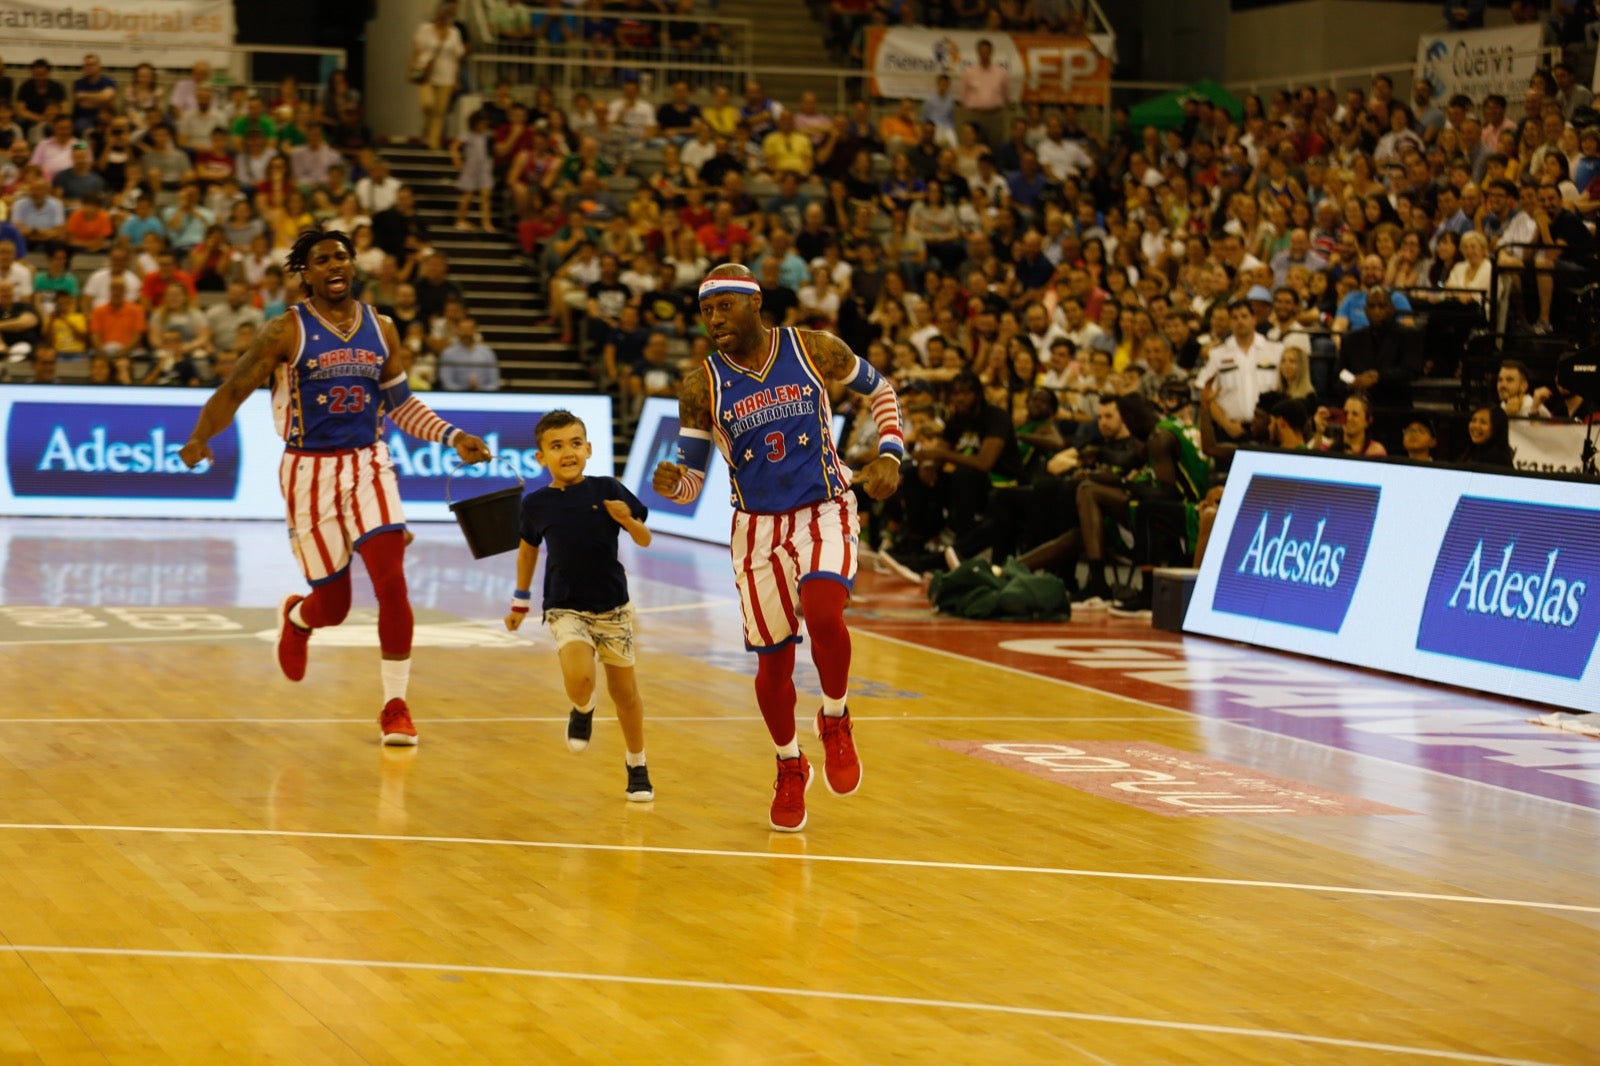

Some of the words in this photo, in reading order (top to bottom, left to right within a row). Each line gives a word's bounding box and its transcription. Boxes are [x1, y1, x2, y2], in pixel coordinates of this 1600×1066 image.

[1028, 47, 1098, 93] FP
[319, 347, 376, 368] HARLEM
[328, 385, 365, 414] 23
[733, 383, 802, 420] HARLEM
[764, 430, 786, 462] 3
[1238, 510, 1346, 588] Adeslas
[1448, 539, 1587, 627] Adeslas
[997, 637, 1600, 785] GRANA
